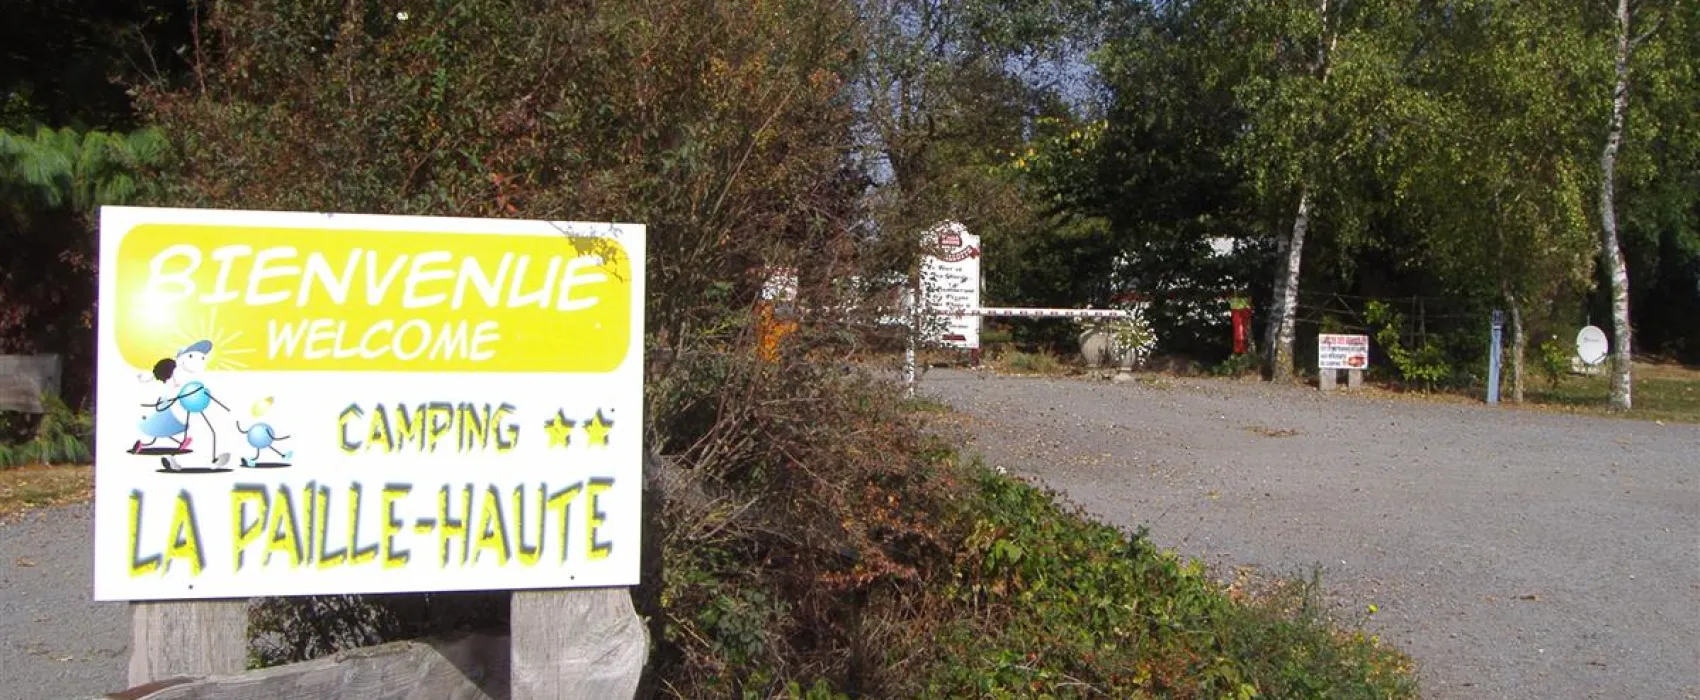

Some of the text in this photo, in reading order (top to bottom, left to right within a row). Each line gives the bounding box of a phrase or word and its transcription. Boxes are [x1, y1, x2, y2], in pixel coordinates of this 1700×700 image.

[141, 244, 608, 309] BIENVENUE
[266, 319, 500, 361] WELCOME
[338, 402, 520, 453] CAMPING
[128, 476, 615, 577] LA PAILLE-HAUTE
